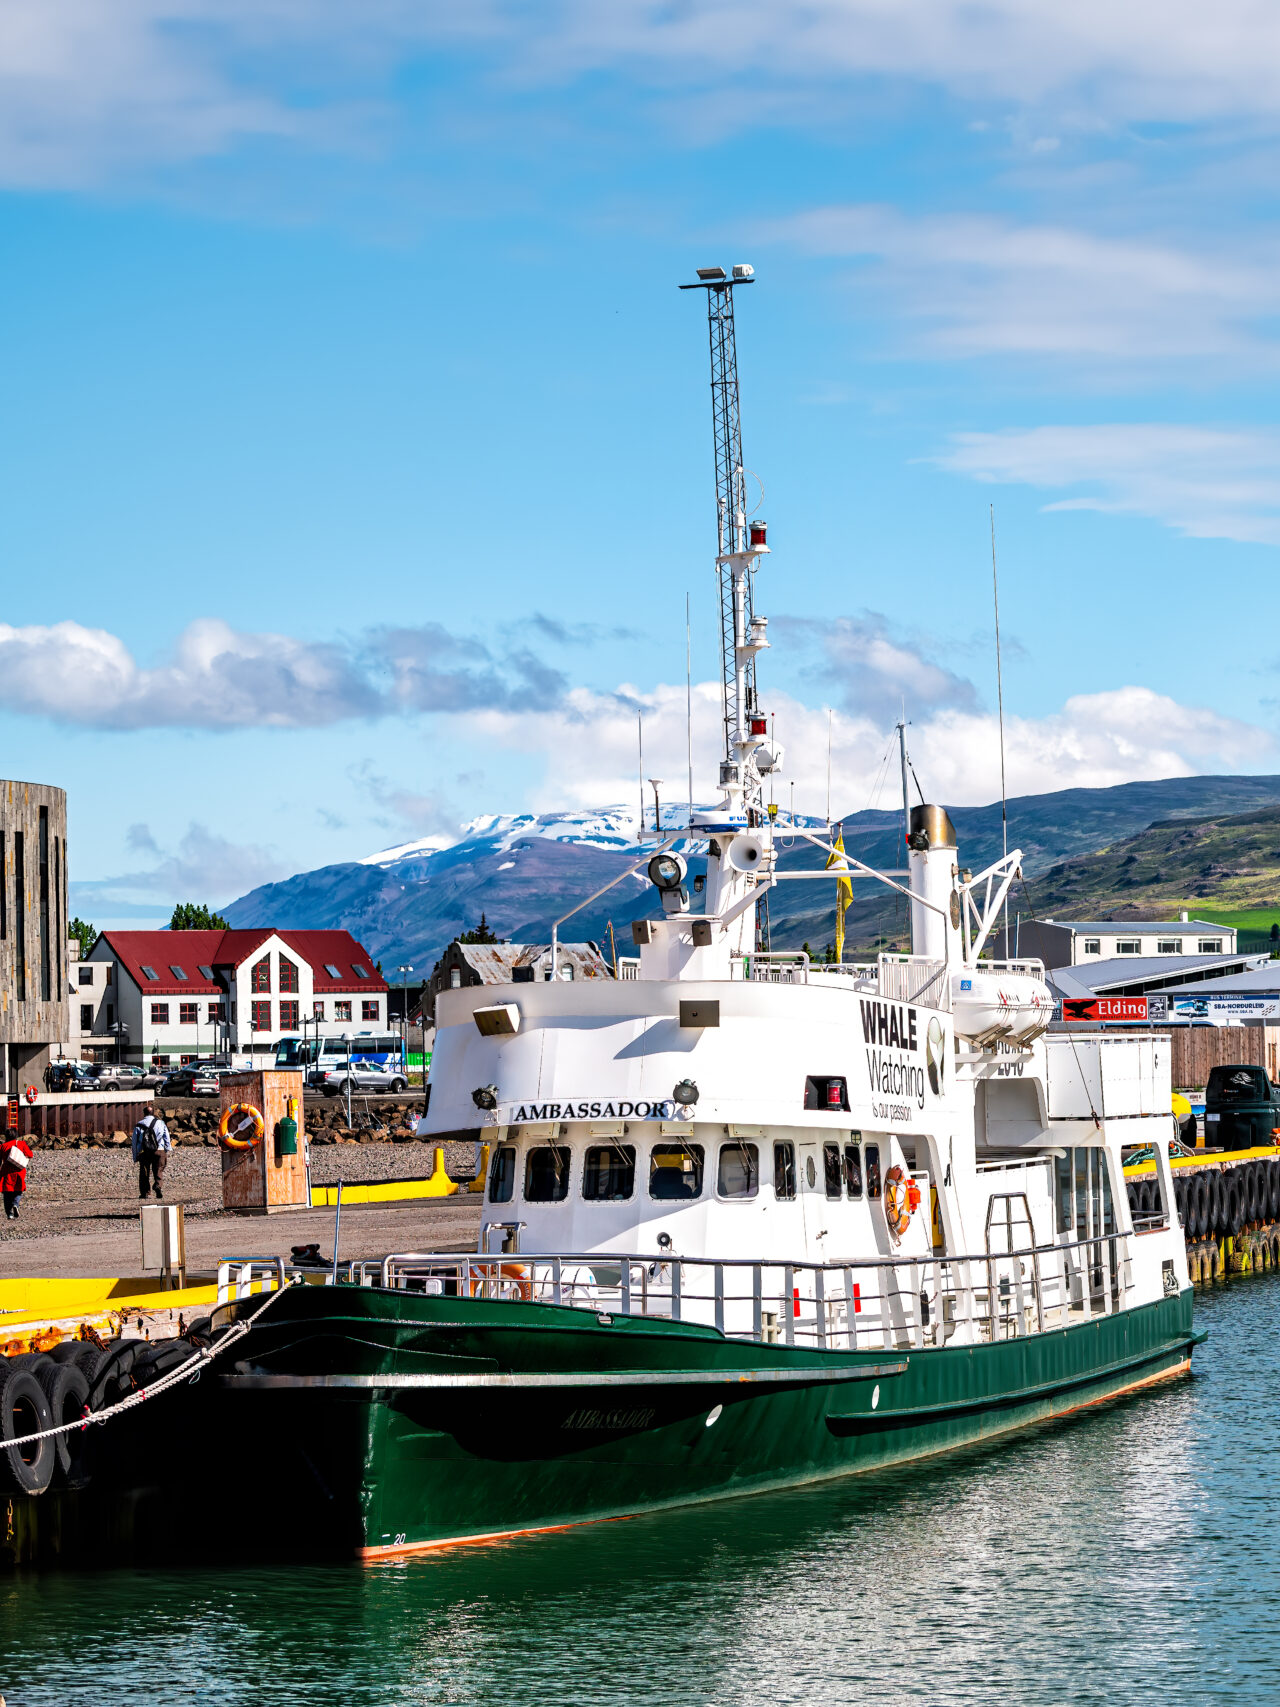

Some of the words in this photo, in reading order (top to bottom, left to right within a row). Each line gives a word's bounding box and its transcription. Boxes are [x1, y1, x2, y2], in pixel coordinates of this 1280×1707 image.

[1097, 1000, 1146, 1017] Elding
[859, 999, 918, 1052] WHALE
[865, 1048, 925, 1110] Watching
[513, 1101, 668, 1122] AMBASSADOR
[872, 1096, 879, 1118] is
[879, 1102, 889, 1119] our
[889, 1101, 913, 1124] passion
[393, 1532, 407, 1546] 20
